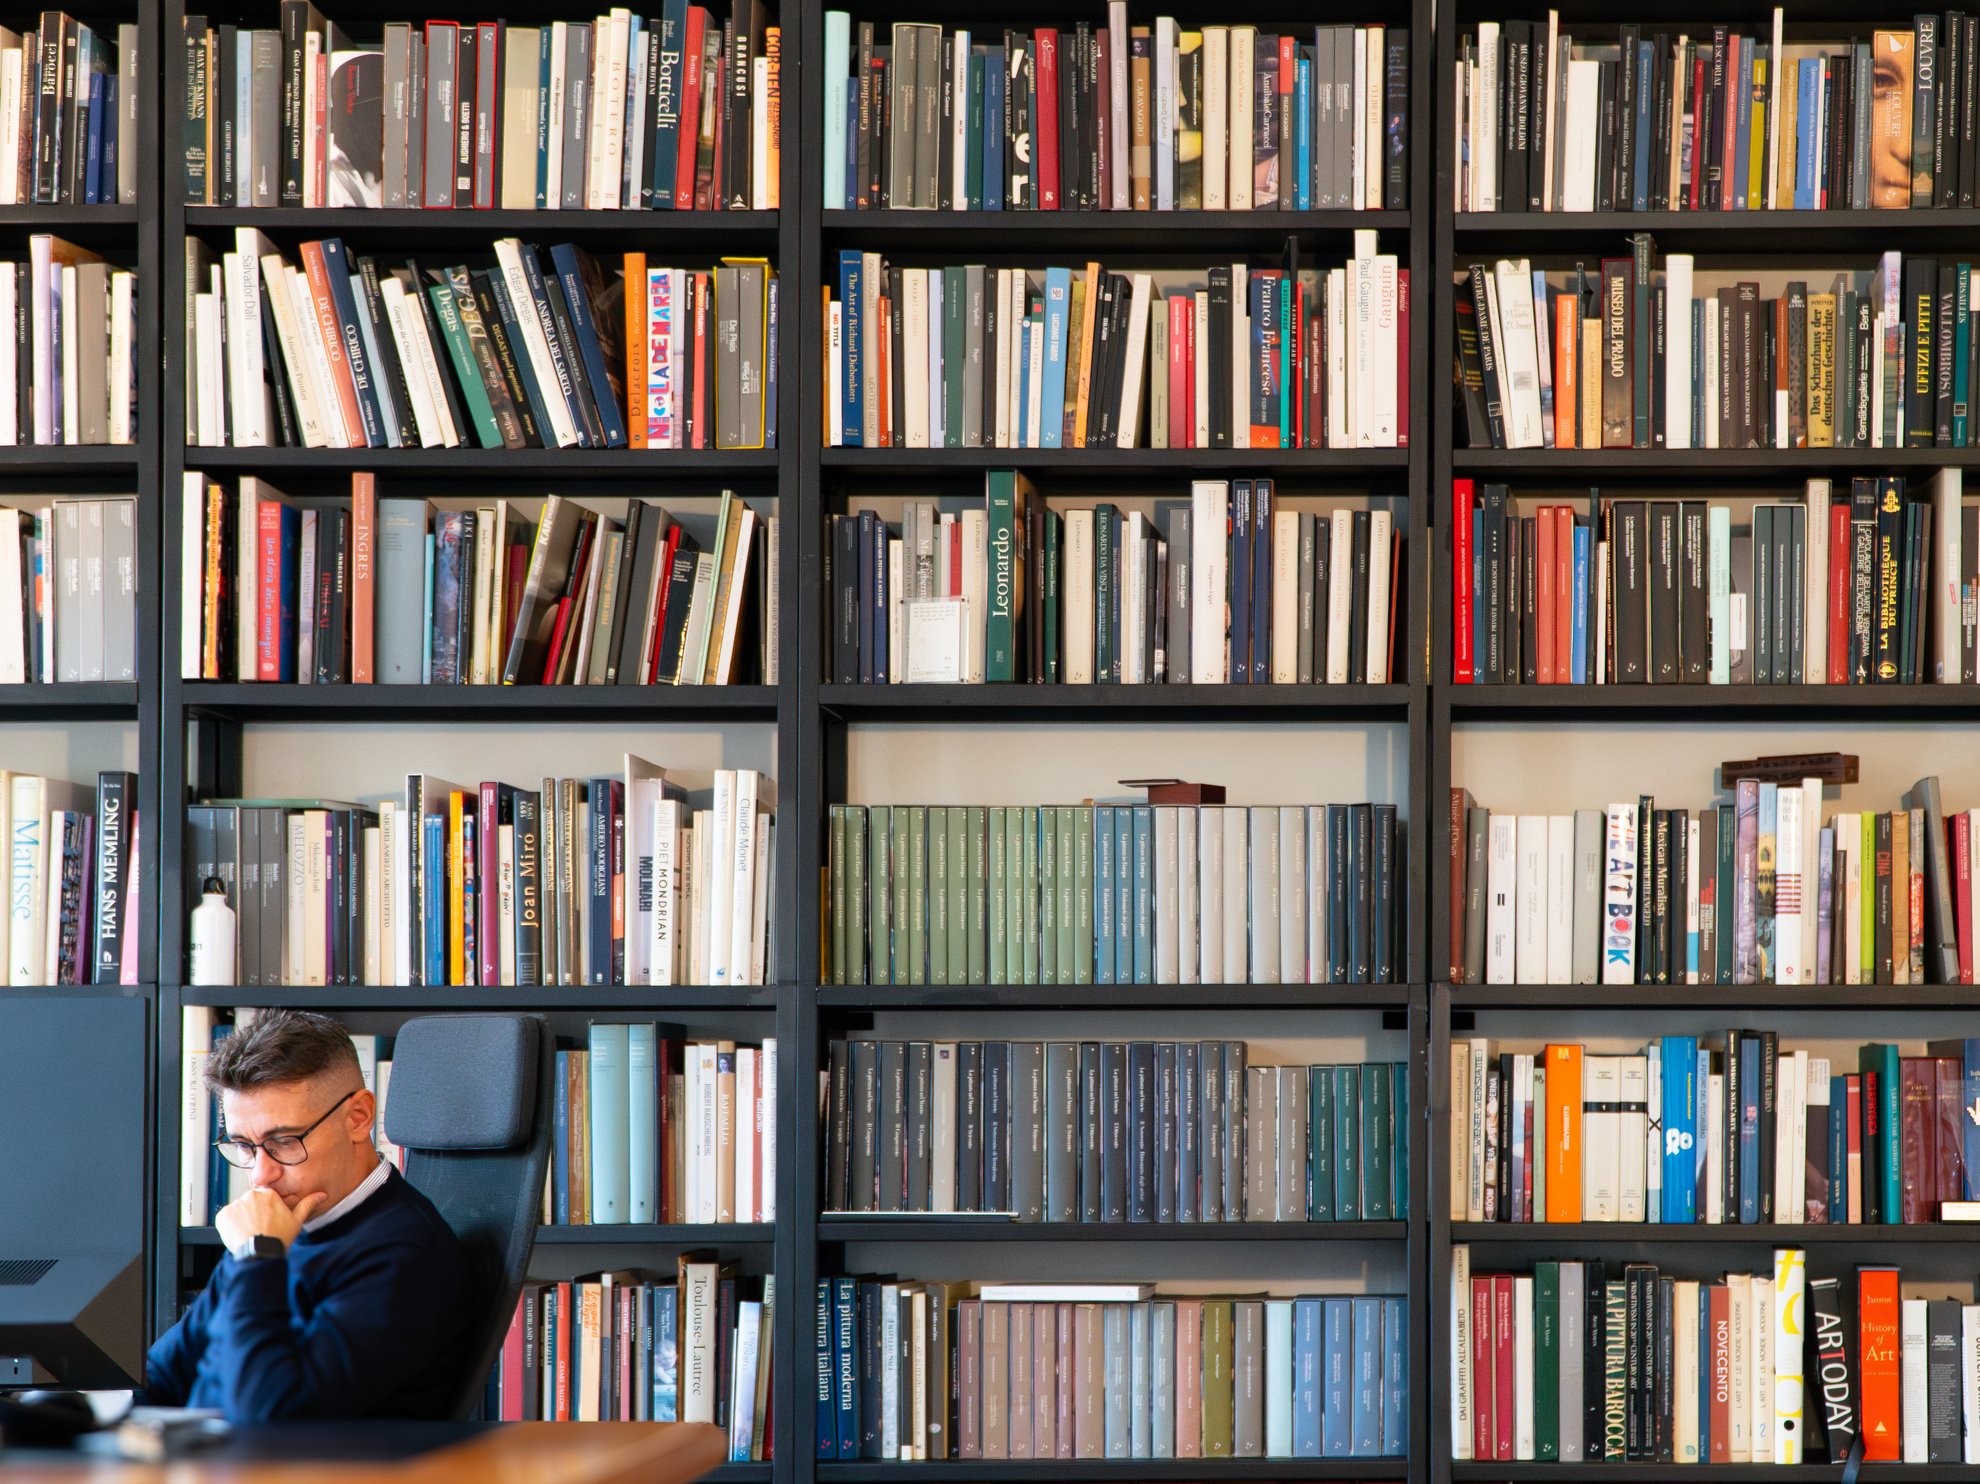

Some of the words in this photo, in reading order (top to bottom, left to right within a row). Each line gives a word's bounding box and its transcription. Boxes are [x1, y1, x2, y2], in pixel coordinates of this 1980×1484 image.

[1716, 31, 1724, 41] EL
[42, 43, 57, 95] Barocci
[196, 49, 205, 69] MAX
[736, 36, 748, 97] BRANCUSI
[1520, 44, 1528, 72] MUSEO
[1714, 44, 1724, 88] ESCORIAL
[1919, 23, 1934, 91] LOUVRE
[195, 71, 206, 119] BECKMANN
[657, 50, 680, 130] Botticelli
[1136, 78, 1144, 137] CARAVAGGIO
[1519, 74, 1527, 114] GIOVANNI
[461, 102, 471, 121] BOETTI
[1891, 91, 1901, 139] LOUVRE
[460, 129, 470, 164] ALIGHIERO
[1518, 116, 1526, 150] BOLDINI
[242, 255, 255, 297] Salvador
[849, 273, 859, 290] The
[1360, 258, 1371, 279] Paul
[243, 300, 257, 321] Dalí
[317, 296, 329, 309] DE
[437, 288, 459, 332] Degas
[508, 266, 526, 292] Edgar
[517, 295, 533, 325] Degas
[849, 291, 859, 306] Art
[849, 307, 858, 317] of
[1359, 281, 1371, 323] Gauguin
[1378, 264, 1392, 328] Gauguin
[1473, 270, 1486, 330] NOTRE-DAME
[1612, 276, 1625, 315] MUSEO
[1916, 294, 1930, 332] PITTI
[1958, 269, 1968, 324] VERSAILLES
[320, 310, 341, 362] CHIRICO
[536, 299, 557, 341] ANDREA
[729, 320, 738, 330] De
[833, 313, 839, 325] NO
[849, 319, 859, 352] Richard
[1611, 317, 1625, 338] DEL
[1811, 309, 1822, 326] der
[1859, 305, 1869, 330] Berlin
[345, 324, 366, 372] CHIRICO
[549, 341, 562, 360] DEL
[728, 331, 738, 353] Pisis
[1482, 332, 1489, 345] DE
[1484, 346, 1494, 371] PARIS
[1611, 339, 1625, 377] PRADO
[1822, 309, 1834, 368] Geschichte
[1917, 336, 1930, 345] E
[1939, 292, 1954, 399] VALLOMBROSA
[555, 362, 573, 396] SARTO
[741, 361, 750, 382] Pisis
[848, 354, 859, 403] Diebenkorn
[1811, 328, 1822, 391] Schatzhaus
[1916, 349, 1930, 395] UFFIZI
[355, 373, 369, 389] DE
[630, 343, 642, 417] Delacroix
[741, 383, 750, 394] De
[1822, 371, 1833, 427] deutschen
[1811, 393, 1822, 416] Das
[1857, 373, 1869, 441] Gemäldegalerie
[266, 537, 274, 554] Una
[464, 515, 472, 538] JIKI
[358, 525, 368, 580] INGRES
[1099, 556, 1106, 567] DA
[1864, 529, 1872, 573] CAPOLAVORI
[992, 527, 1009, 618] Leonardo
[1099, 568, 1107, 592] VINCI
[1881, 535, 1890, 629] BIBLIOTHÈQUE
[1889, 559, 1897, 610] PRINCE
[265, 588, 274, 609] delle
[1855, 573, 1863, 634] DELL'ACCADEMIA
[1889, 611, 1896, 626] DU
[259, 612, 274, 659] immagini
[1863, 617, 1871, 657] VENEZIANA
[1880, 633, 1888, 649] LA
[741, 798, 750, 840] Claude
[1452, 793, 1460, 824] Musée
[104, 797, 120, 884] MEMLING
[1451, 827, 1459, 858] d'Orsay
[1610, 814, 1634, 850] THE
[1658, 821, 1669, 865] Mexican
[12, 819, 40, 920] Matisse
[293, 824, 303, 886] MELOZZO
[519, 833, 535, 878] Miró
[659, 841, 668, 867] PIET
[739, 842, 748, 872] Monet
[1876, 851, 1889, 877] CINA
[639, 855, 653, 912] MOLINARI
[1608, 857, 1634, 900] ART
[1657, 868, 1668, 917] Muralists
[102, 888, 117, 939] HANS
[521, 887, 539, 928] Joan
[657, 870, 668, 940] MONDRIAN
[1608, 903, 1634, 966] BOOK
[840, 1283, 853, 1300] La
[1606, 1285, 1625, 1307] LA
[1867, 1295, 1892, 1304] Janson
[693, 1275, 708, 1396] Toulouse-Lautrec
[839, 1305, 854, 1349] pittura
[1459, 1308, 1467, 1366] ALL'ALFABETO
[1605, 1308, 1625, 1376] PITTURA
[1862, 1322, 1898, 1335] History
[1875, 1334, 1884, 1345] of
[1716, 1321, 1728, 1403] NOVECENTO
[1865, 1348, 1895, 1361] Art
[841, 1353, 856, 1411] moderna
[1459, 1366, 1467, 1404] GRAFFITI
[1605, 1378, 1625, 1457] BAROCCA
